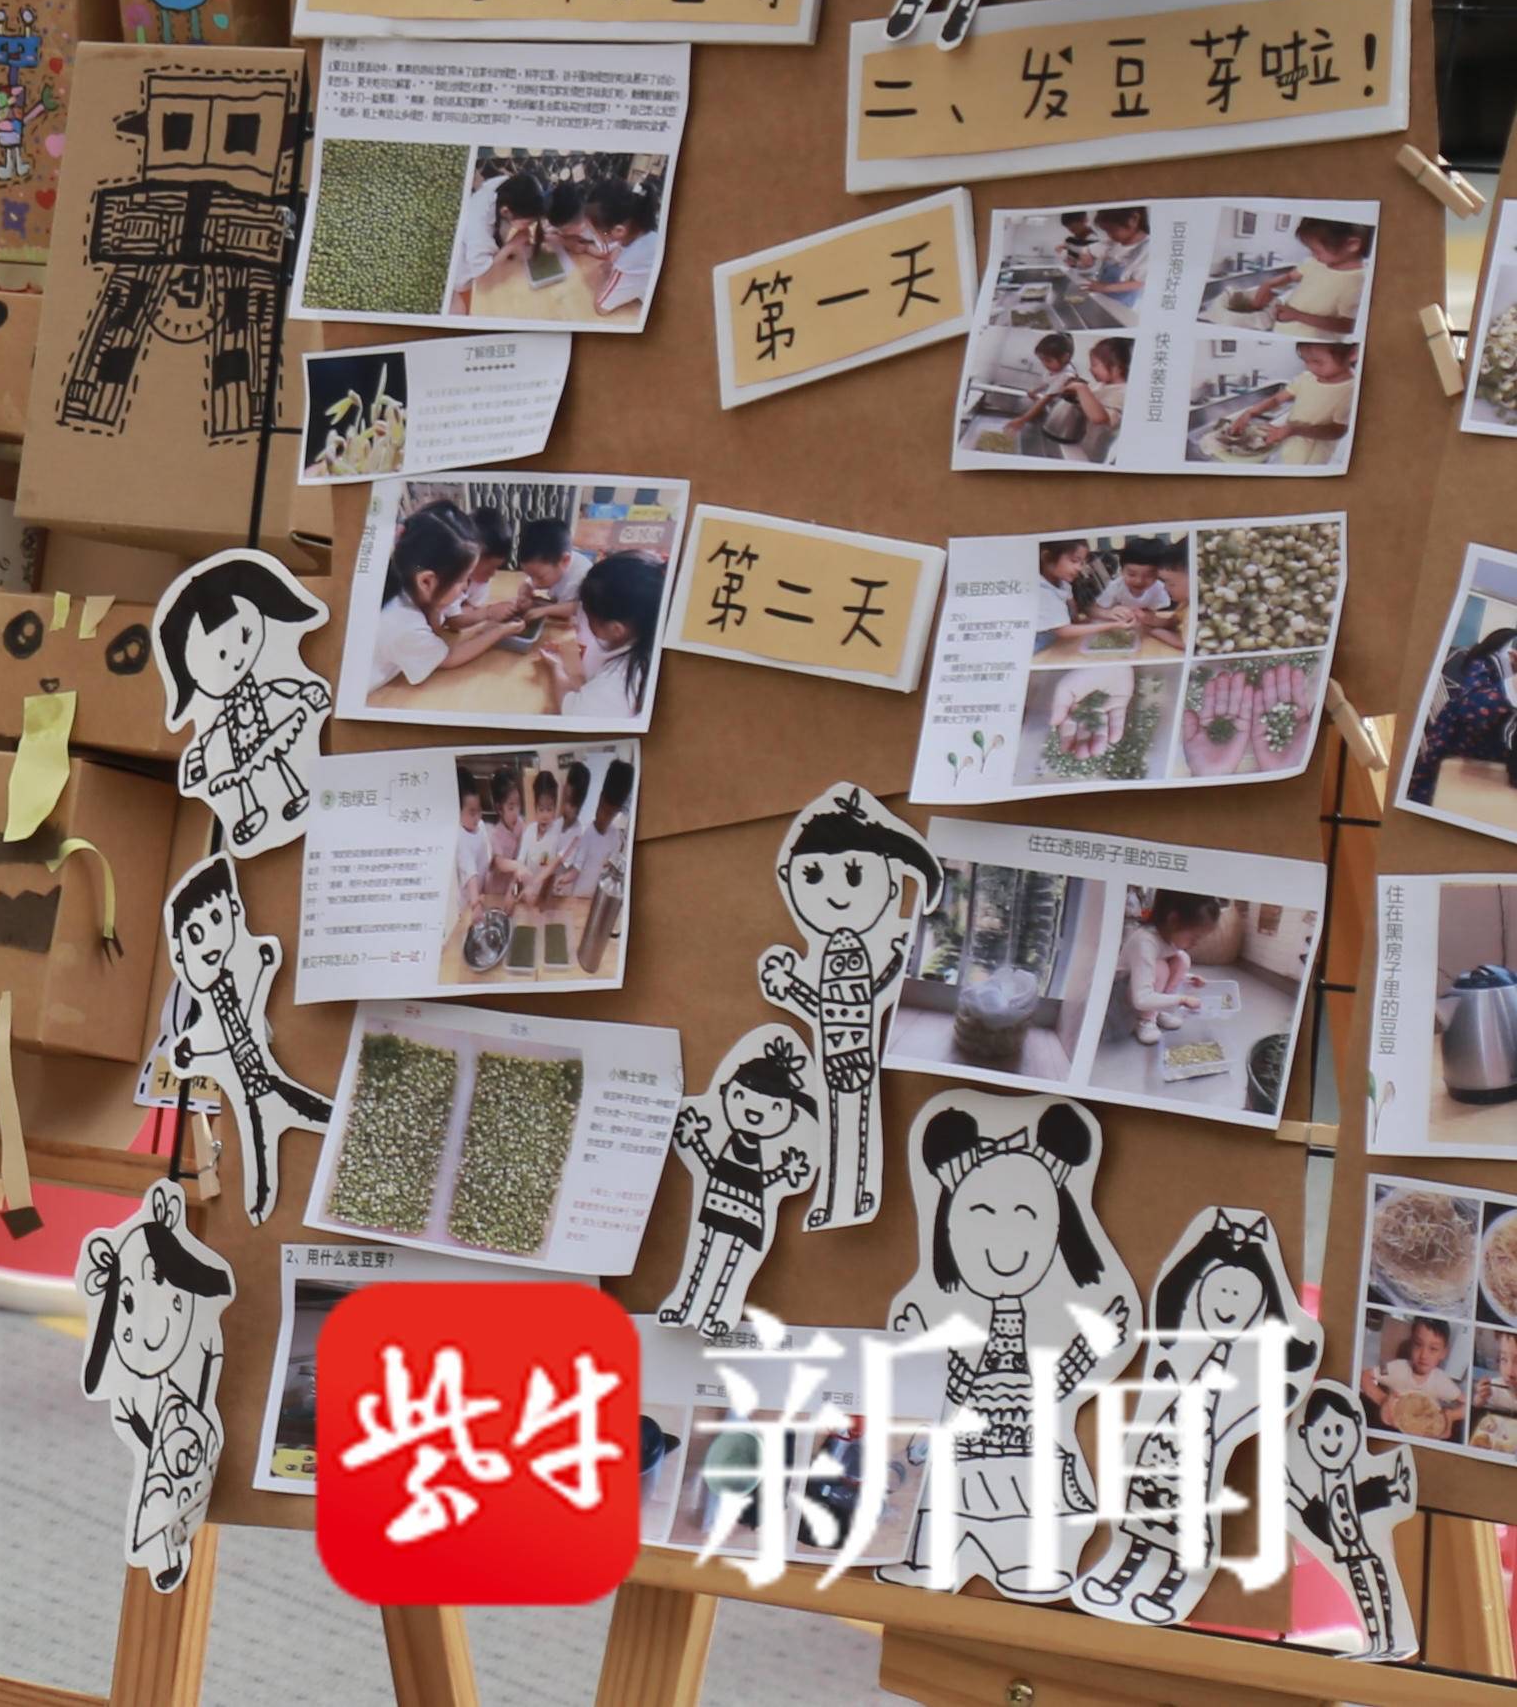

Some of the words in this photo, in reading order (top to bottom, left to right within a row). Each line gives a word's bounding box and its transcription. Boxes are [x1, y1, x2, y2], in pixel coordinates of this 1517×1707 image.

[741, 240, 941, 361] 第一天
[707, 541, 891, 649] 第二天
[1028, 834, 1190, 873] 住在透明房子里的豆豆
[1377, 884, 1405, 1056] 住在黑房子里的豆豆
